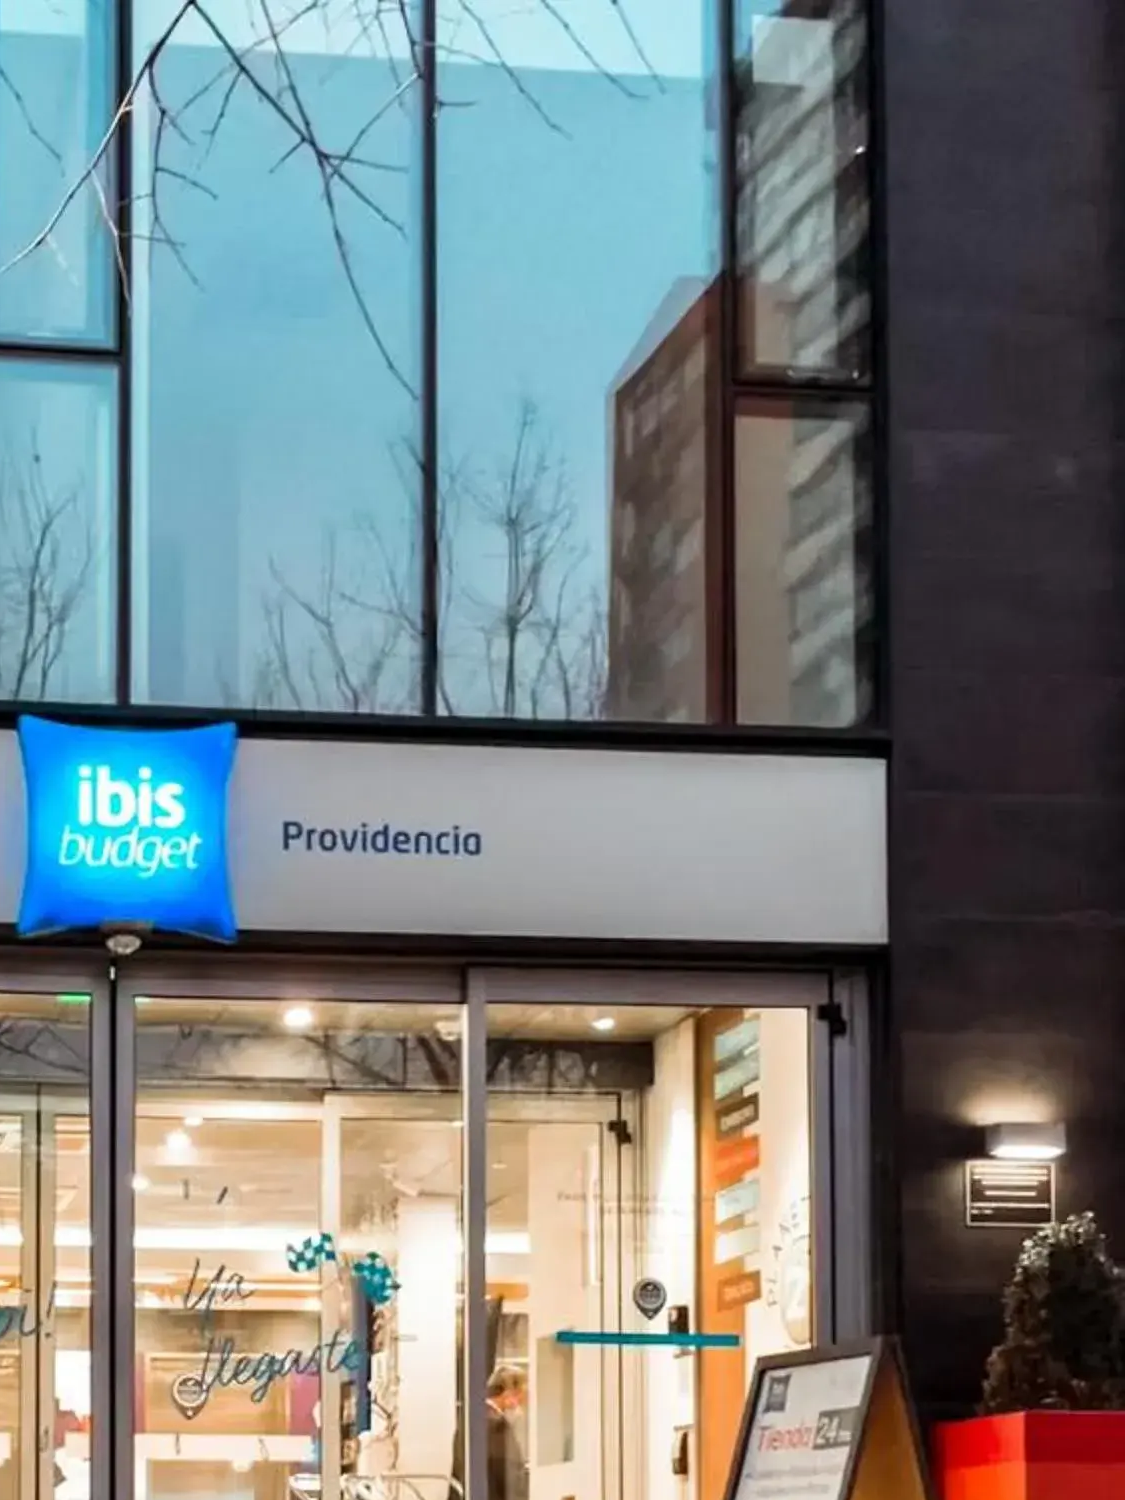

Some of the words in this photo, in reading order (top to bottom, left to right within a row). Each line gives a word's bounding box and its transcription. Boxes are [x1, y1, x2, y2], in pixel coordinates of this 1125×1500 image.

[78, 765, 186, 828] ibis
[58, 825, 202, 878] budget
[282, 821, 483, 857] Providencia
